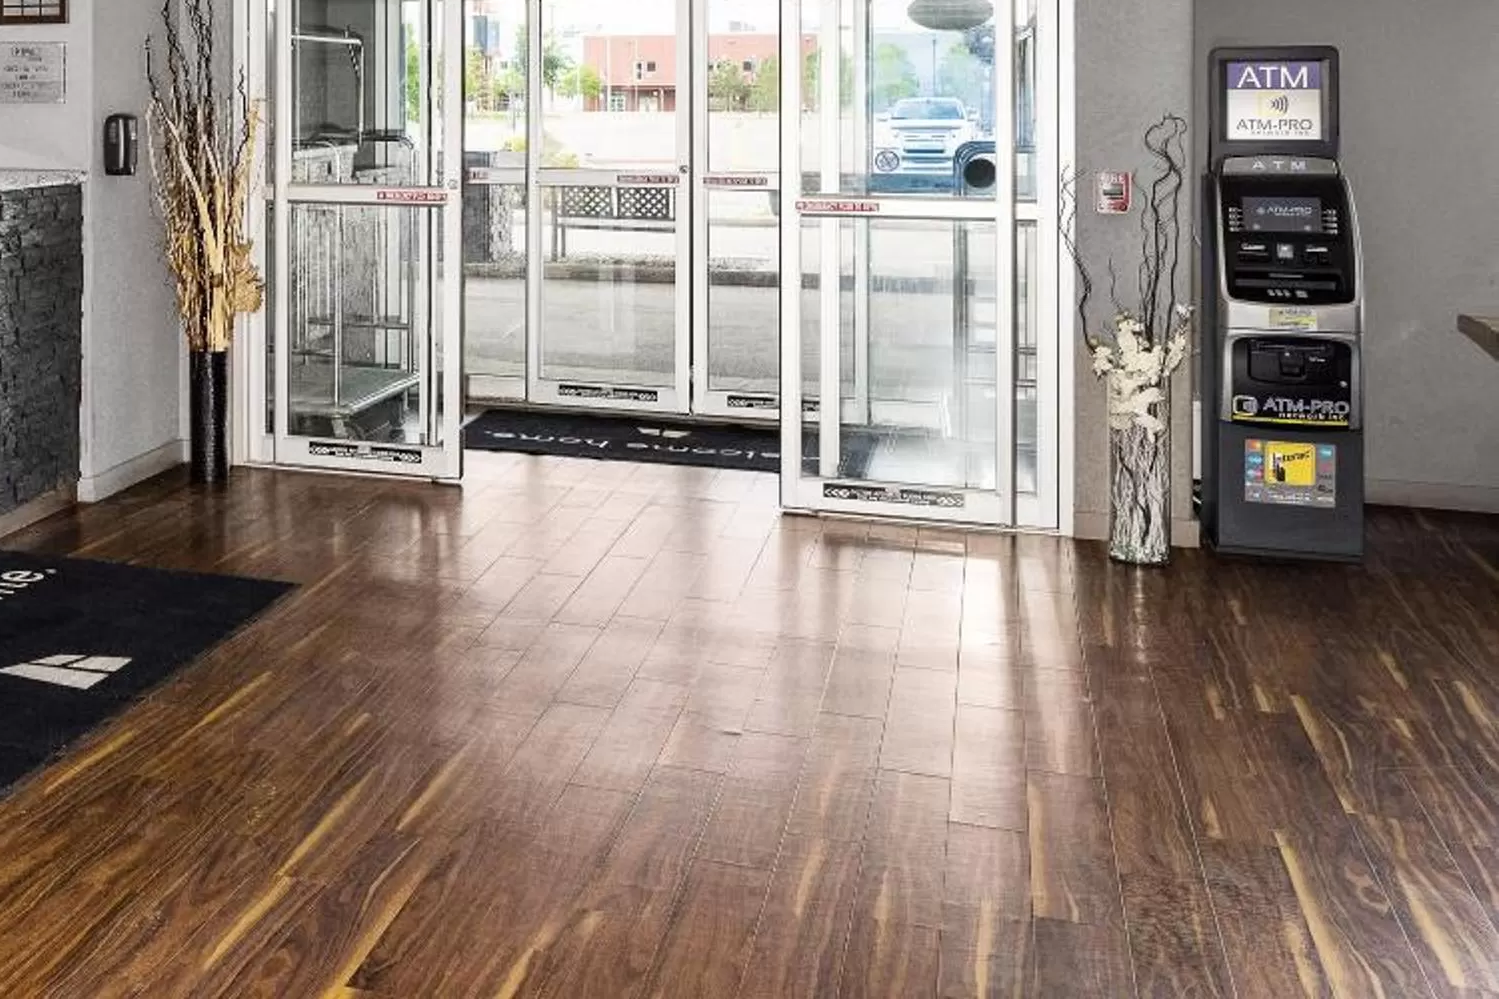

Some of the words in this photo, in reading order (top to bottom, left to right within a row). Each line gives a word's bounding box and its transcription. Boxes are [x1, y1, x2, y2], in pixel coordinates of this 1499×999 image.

[1237, 66, 1308, 88] ATM
[1236, 119, 1313, 130] ATM-PRO
[1252, 160, 1306, 169] ATM
[1263, 398, 1349, 414] ATM-PRO
[627, 442, 780, 459] elcome
